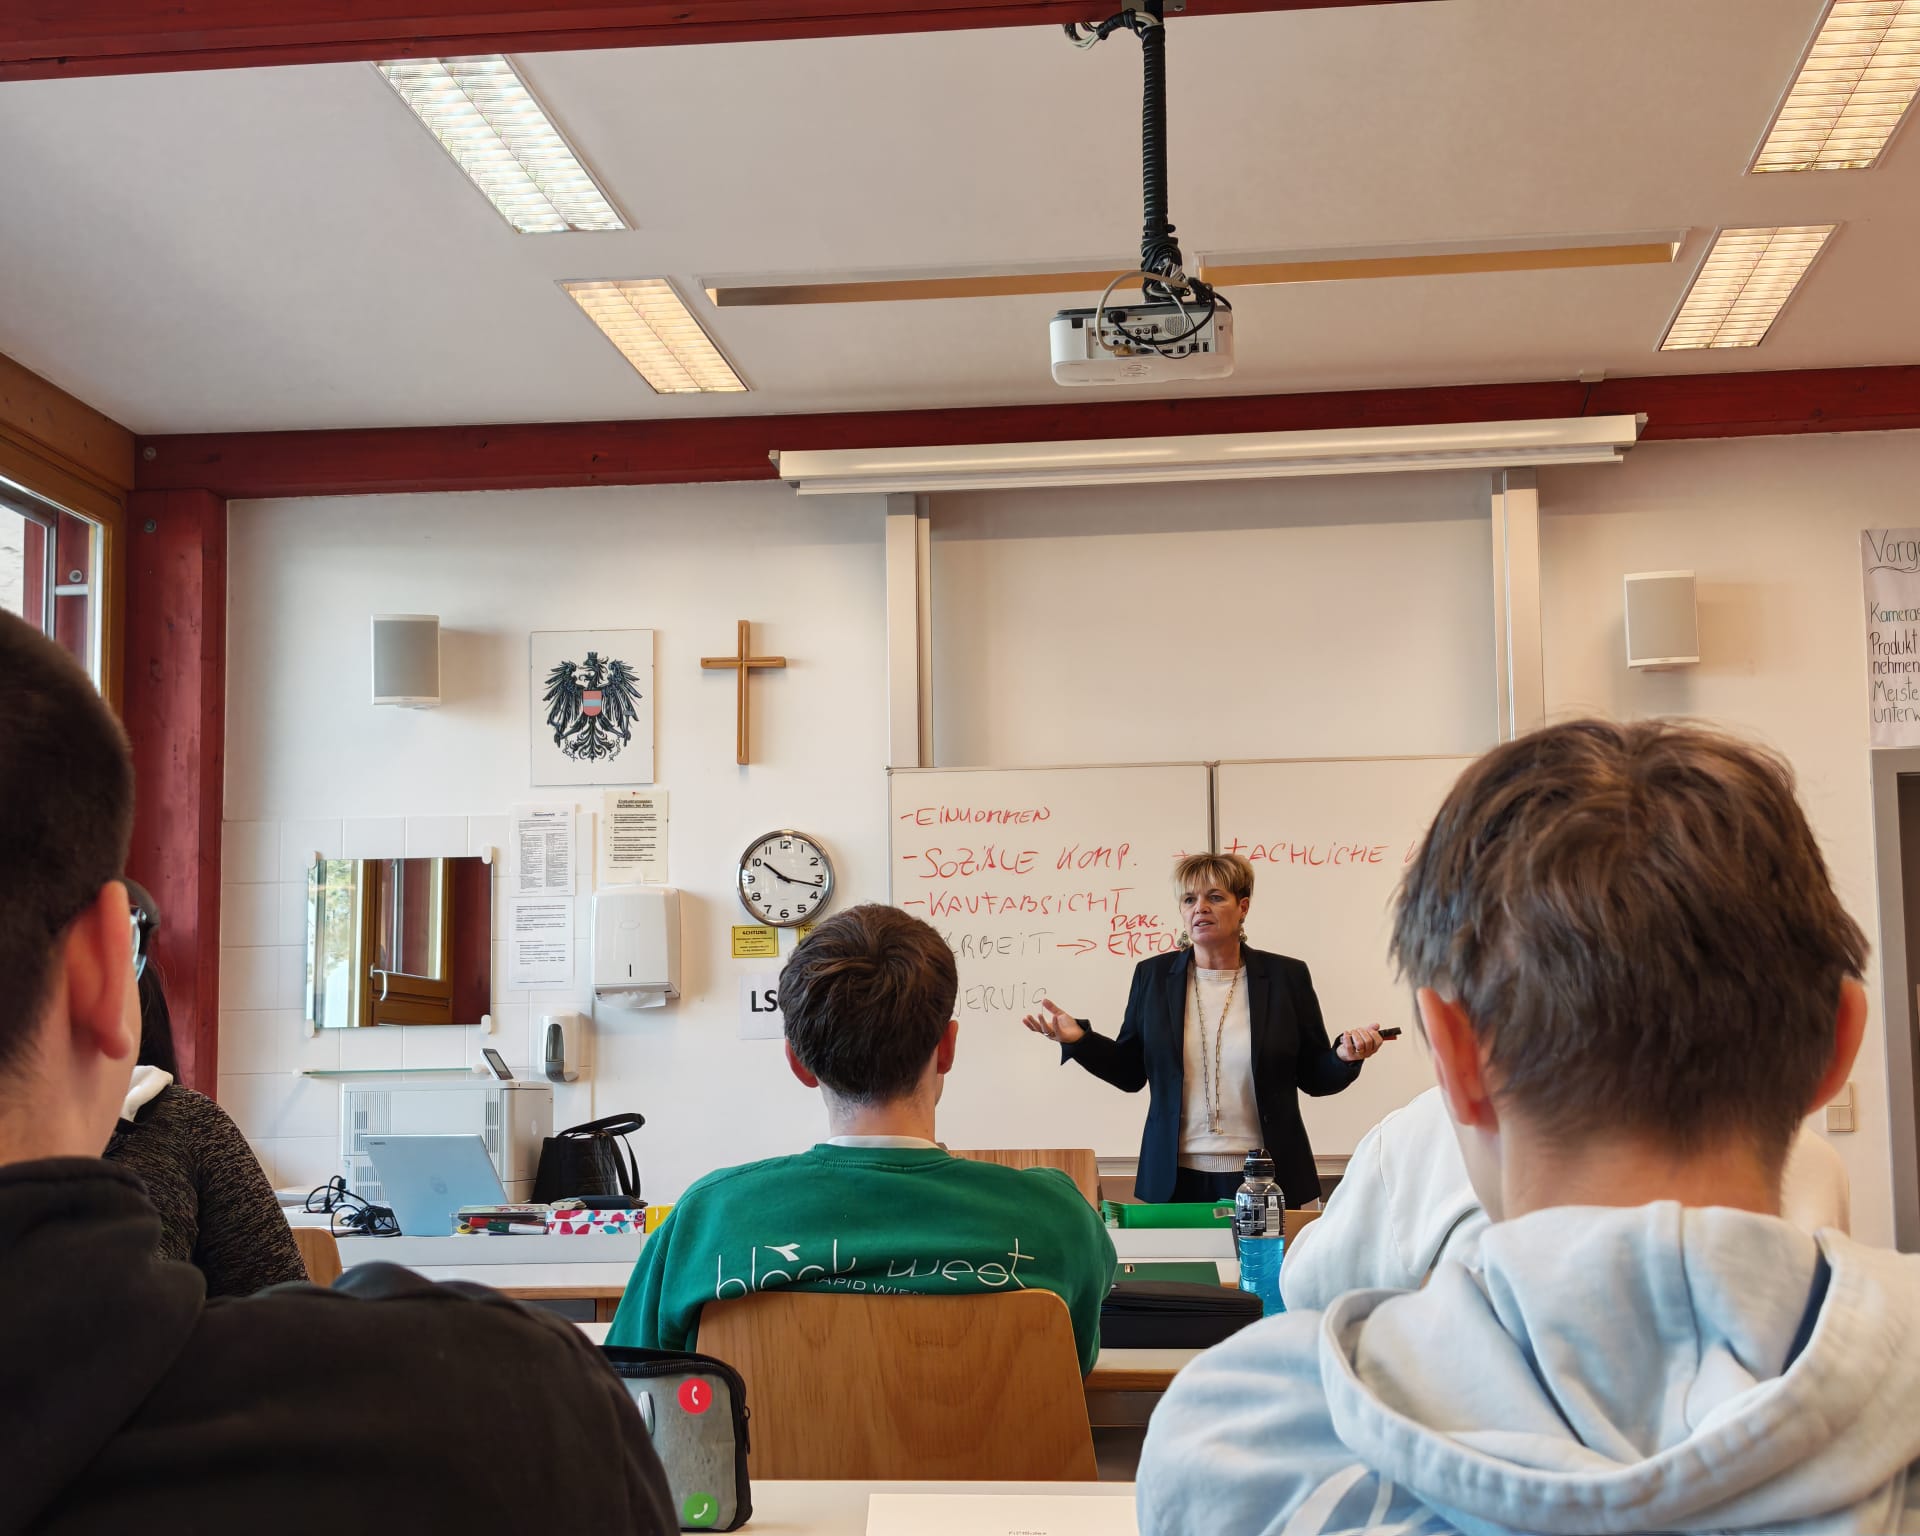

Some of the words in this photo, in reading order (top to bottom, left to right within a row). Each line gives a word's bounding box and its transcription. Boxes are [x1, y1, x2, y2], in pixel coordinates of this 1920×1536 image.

[1869, 628, 1917, 656] Produkt
[780, 840, 792, 850] 12
[764, 846, 772, 856] 11
[752, 858, 762, 867] 10
[809, 857, 819, 866] 2
[814, 874, 824, 884] 3
[751, 892, 762, 902] 8
[809, 890, 819, 900] 4
[764, 904, 773, 914] 7
[780, 909, 790, 918] 6
[797, 904, 807, 913] 5
[887, 1237, 1036, 1289] west
[814, 1275, 867, 1291] APID
